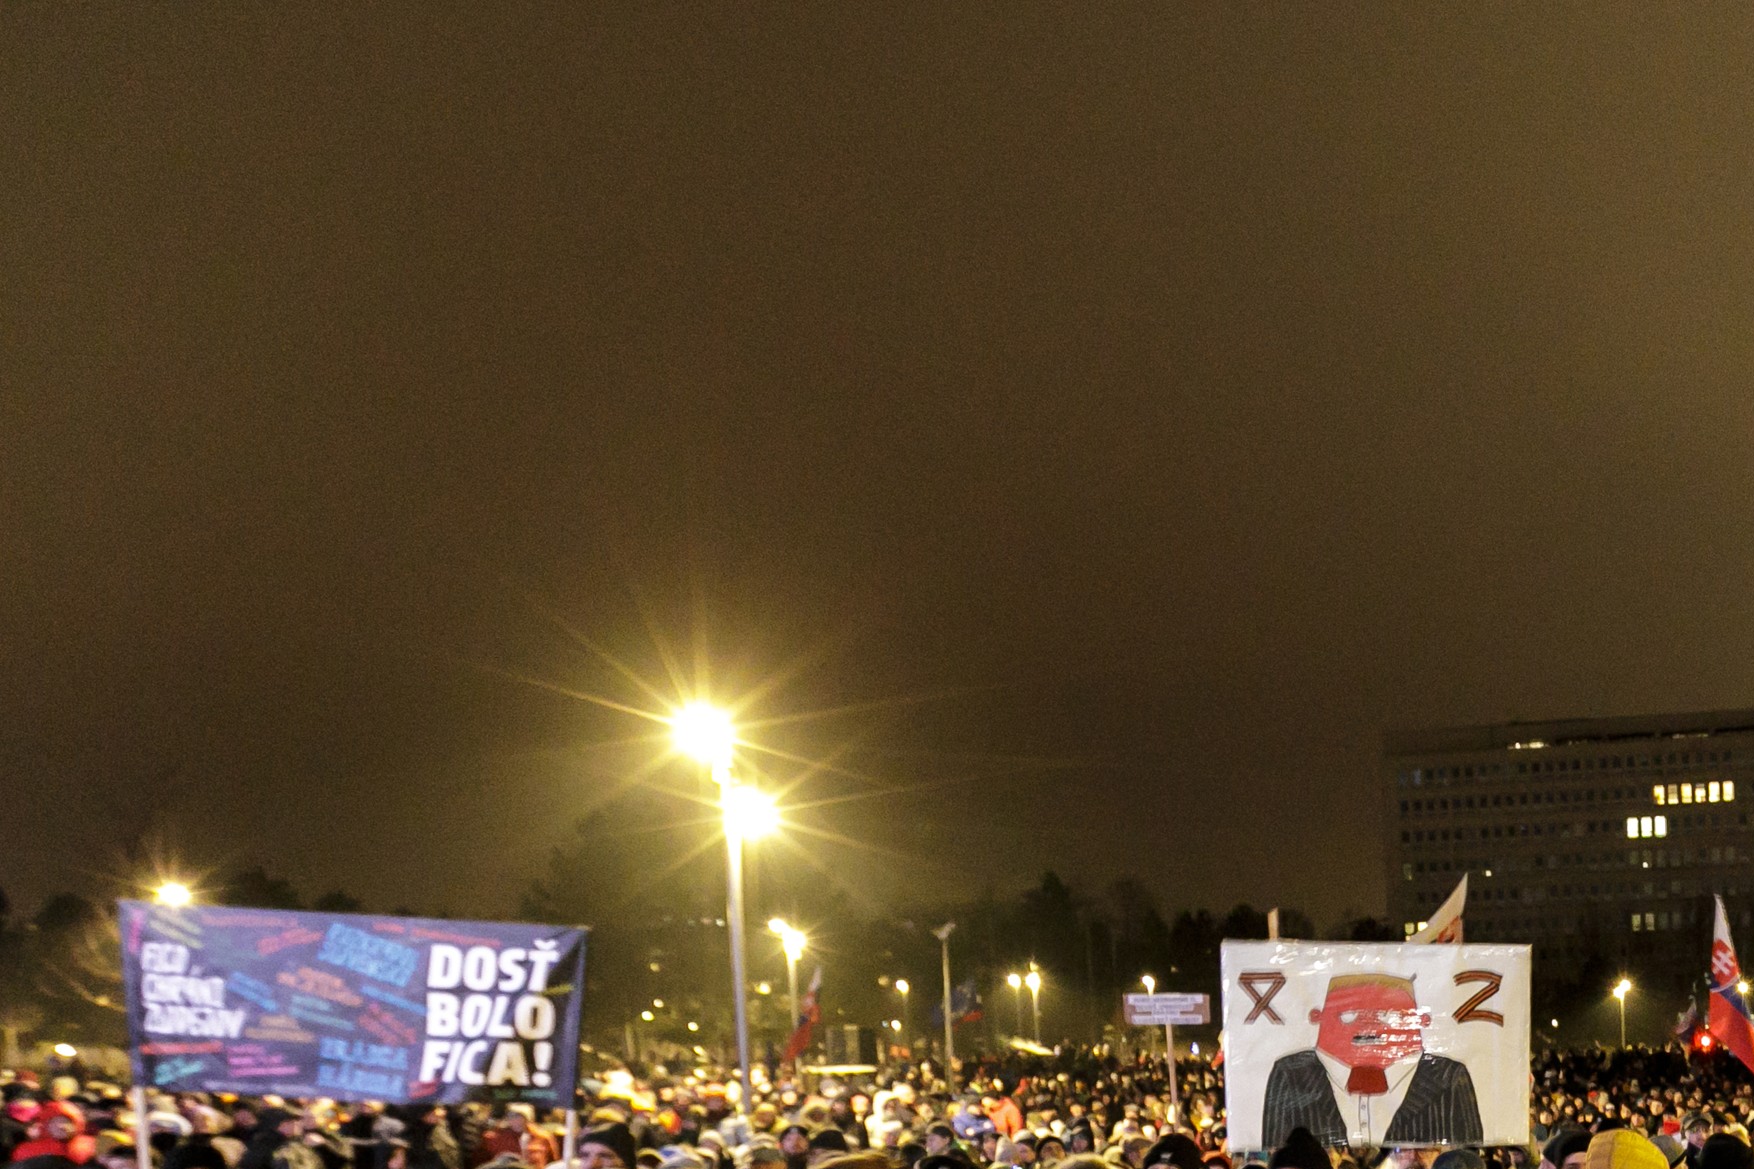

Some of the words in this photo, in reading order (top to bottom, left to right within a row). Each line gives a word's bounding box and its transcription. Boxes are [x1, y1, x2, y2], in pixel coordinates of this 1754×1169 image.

[427, 938, 560, 992] DOSŤ
[426, 991, 556, 1039] BOLO
[419, 1040, 553, 1087] FICA!
